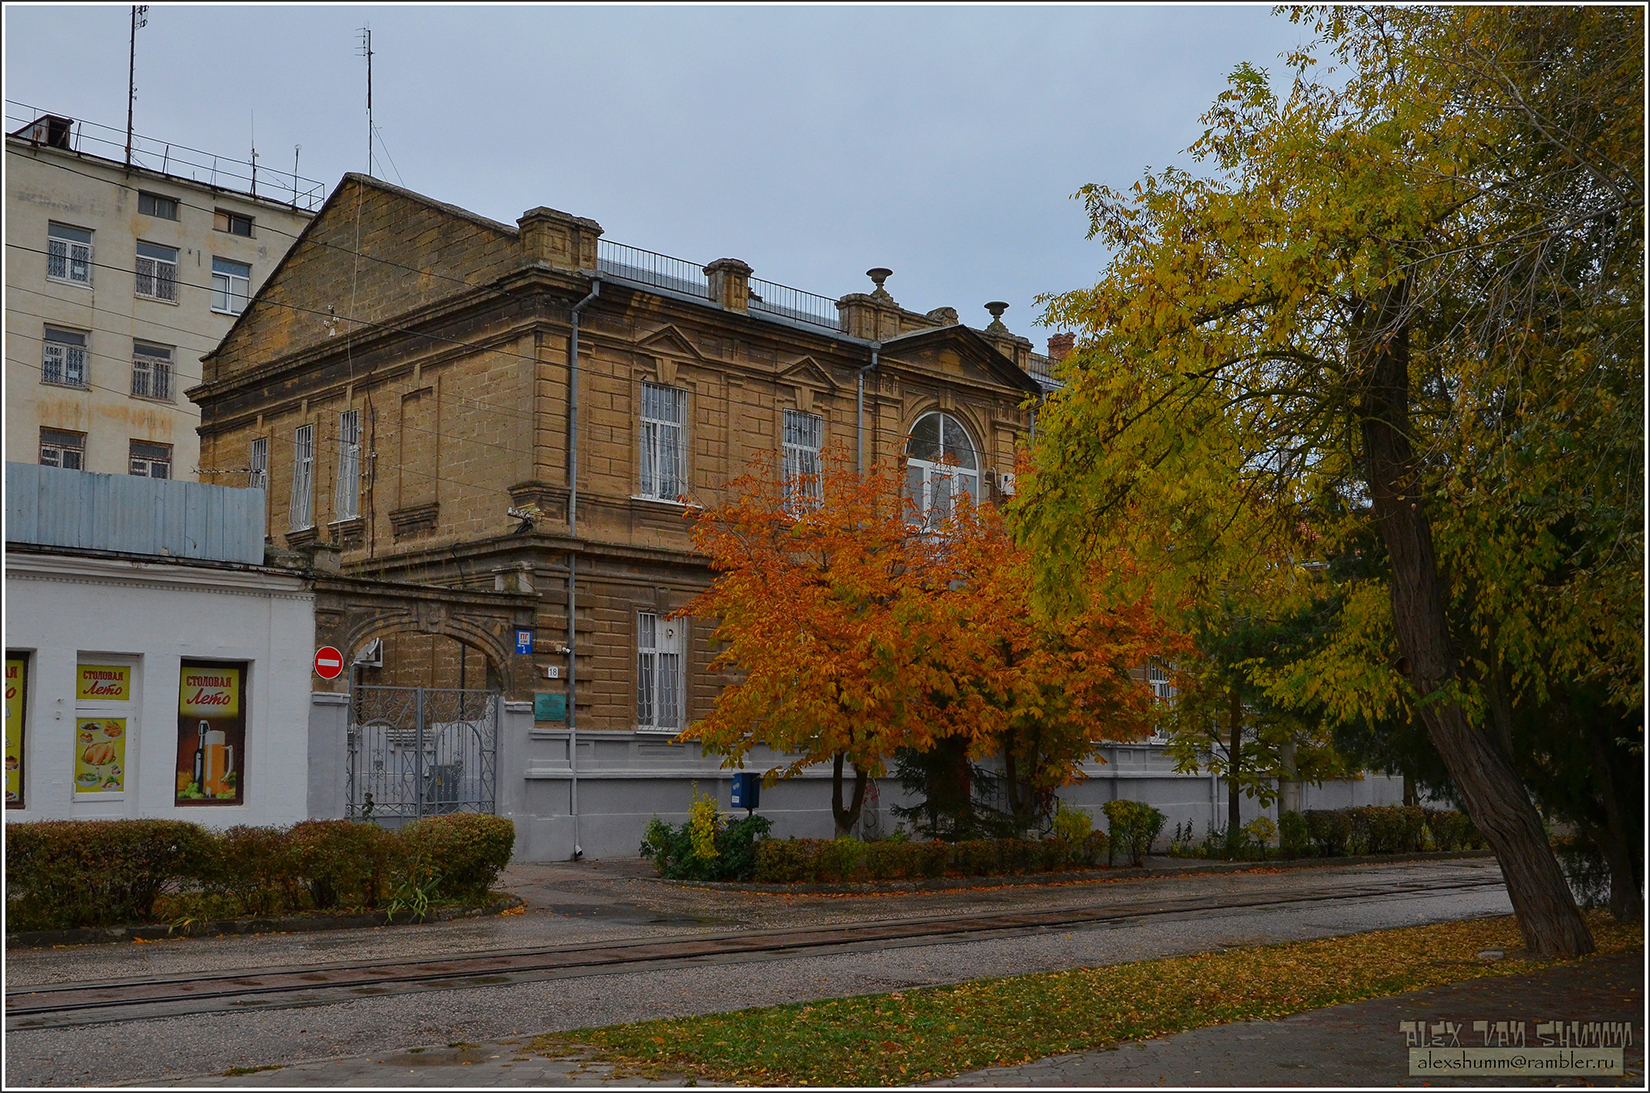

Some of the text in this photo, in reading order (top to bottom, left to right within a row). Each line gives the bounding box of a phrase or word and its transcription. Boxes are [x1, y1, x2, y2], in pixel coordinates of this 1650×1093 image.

[83, 670, 124, 681] СТОЛОВАЯ
[549, 668, 557, 676] 18
[83, 680, 123, 696] Лето
[186, 675, 232, 688] СТОЛОВАЯ
[186, 687, 232, 706] Лето
